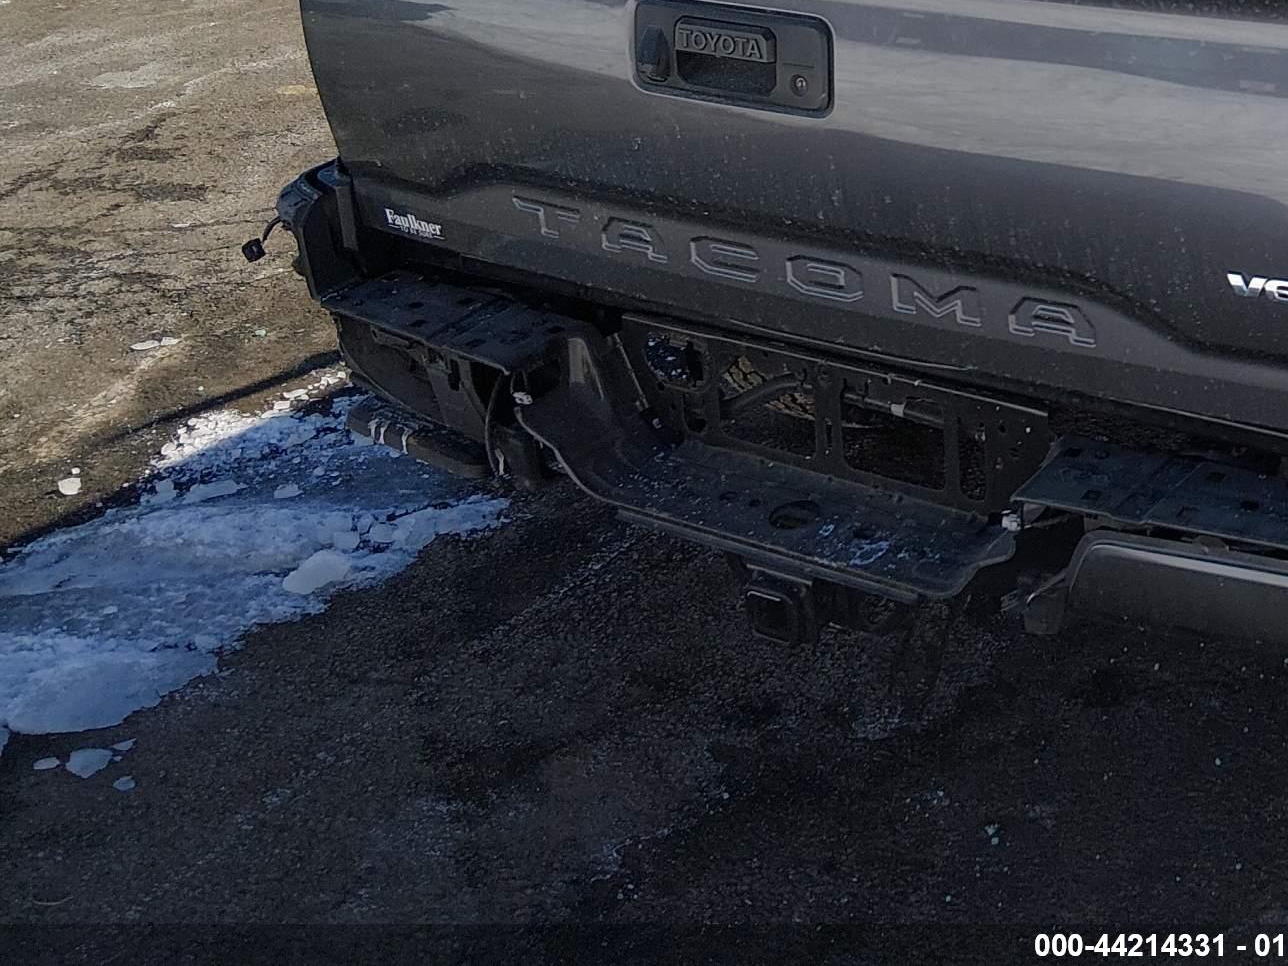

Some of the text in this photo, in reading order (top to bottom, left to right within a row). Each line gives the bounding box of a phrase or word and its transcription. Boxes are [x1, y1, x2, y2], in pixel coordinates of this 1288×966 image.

[678, 29, 763, 59] TOYOTA
[384, 208, 442, 236] Faulkner
[512, 195, 1097, 348] TACOMA
